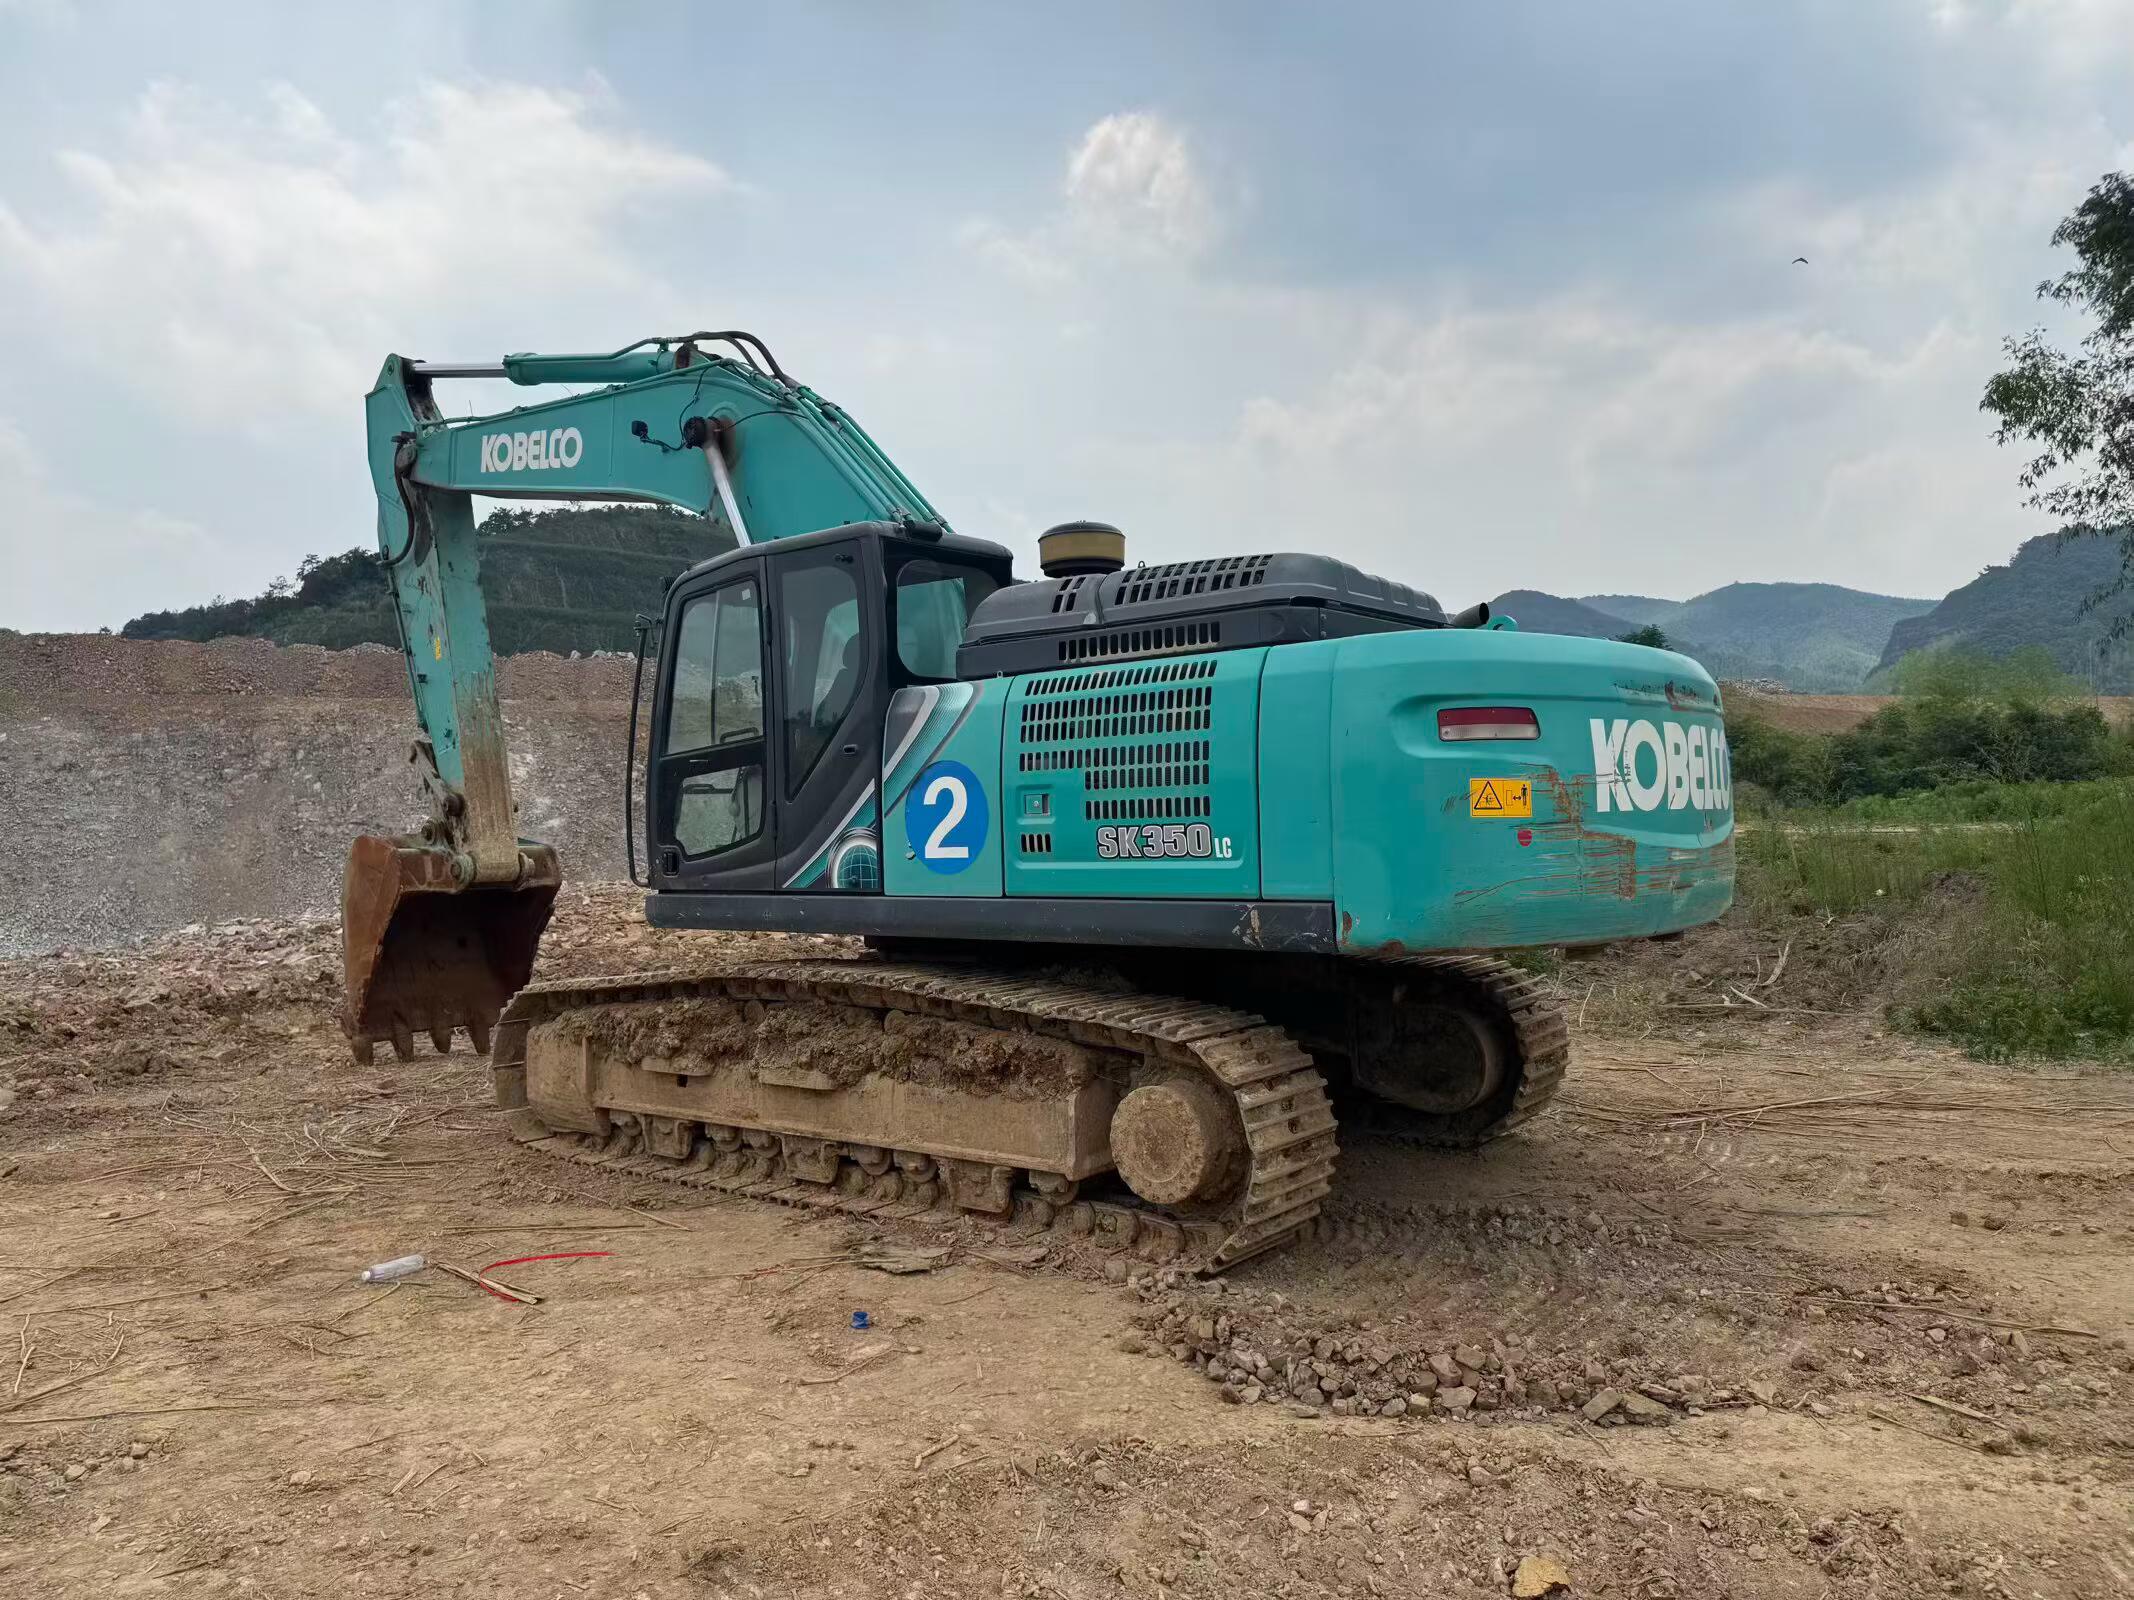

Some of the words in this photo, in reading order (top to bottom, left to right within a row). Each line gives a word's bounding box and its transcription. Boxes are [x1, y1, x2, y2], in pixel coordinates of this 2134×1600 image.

[480, 426, 583, 473] KOBELCO
[1589, 718, 1730, 813] KOBELCO
[923, 775, 969, 859] 2
[1097, 822, 1213, 859] SK350
